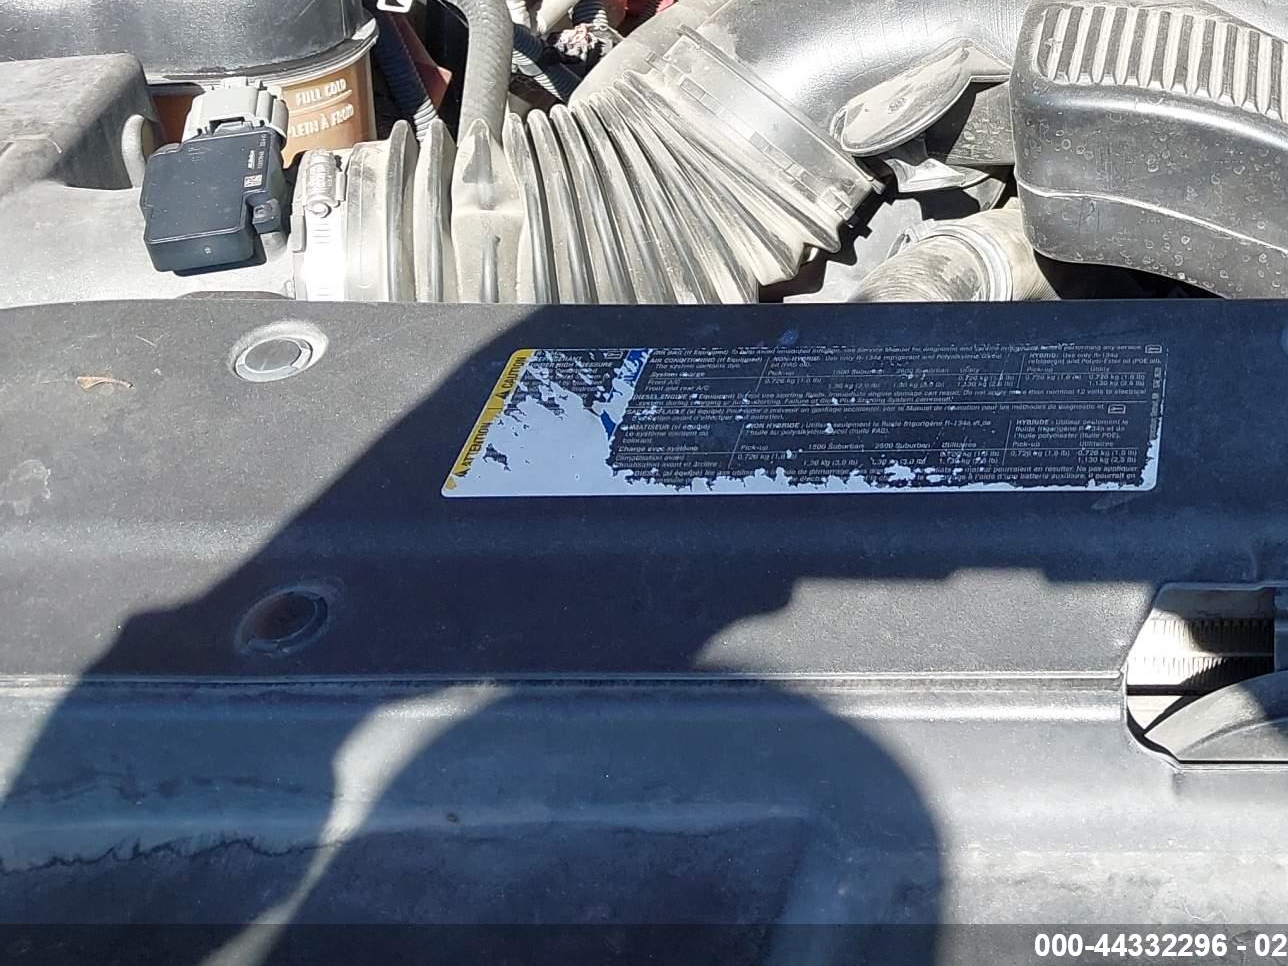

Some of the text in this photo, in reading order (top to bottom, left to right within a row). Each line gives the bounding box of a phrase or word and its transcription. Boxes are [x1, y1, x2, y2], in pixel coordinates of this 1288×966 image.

[296, 78, 347, 106] FULL COLD
[331, 104, 355, 126] FROID
[502, 355, 528, 390] CAUTION
